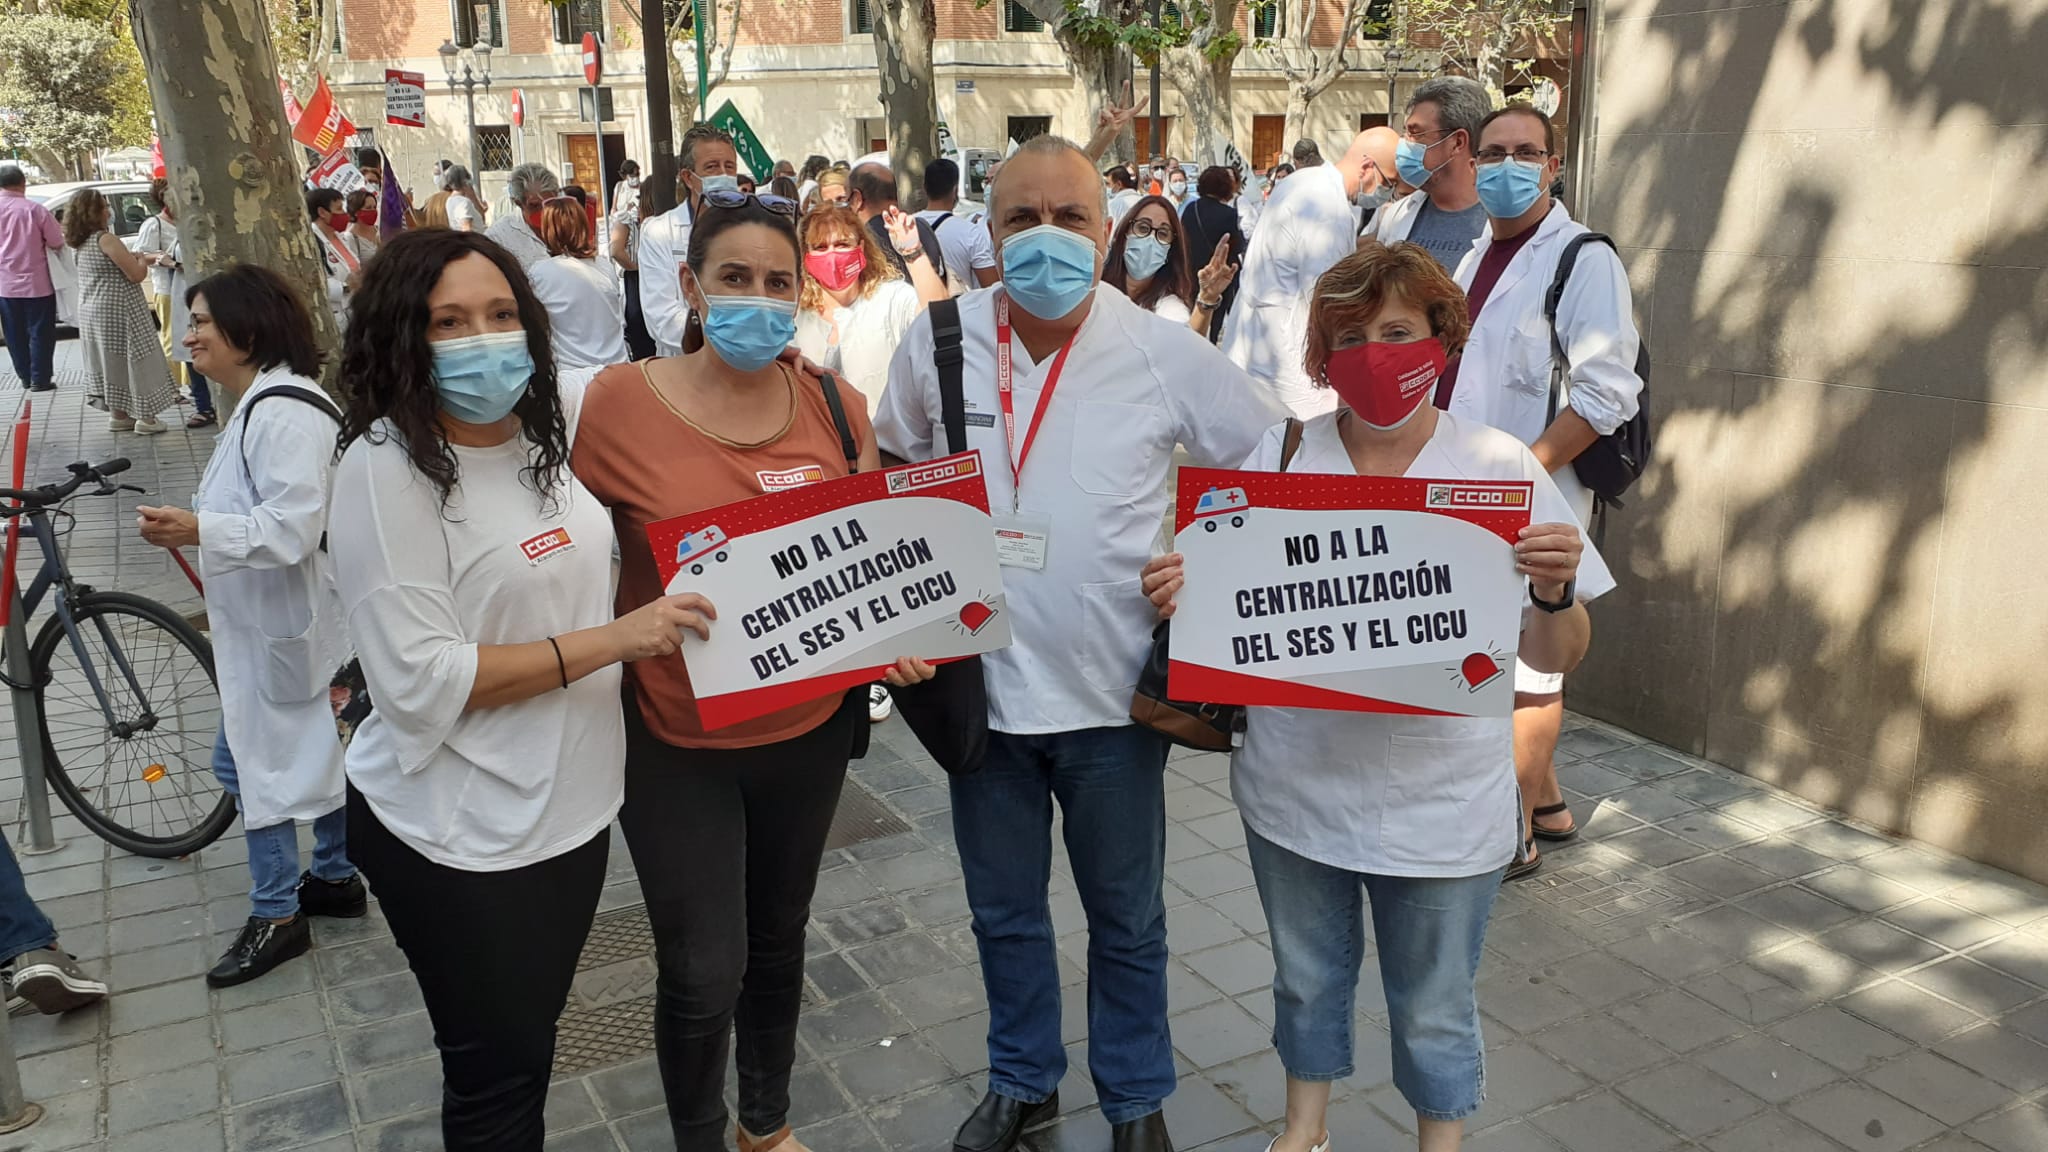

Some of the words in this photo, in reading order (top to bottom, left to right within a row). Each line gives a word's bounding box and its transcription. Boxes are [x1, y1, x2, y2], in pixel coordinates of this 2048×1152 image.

[763, 472, 806, 484] CCOO
[911, 465, 956, 484] CCOO
[1454, 491, 1502, 503] CCOO
[524, 534, 561, 555] CCOO
[770, 544, 808, 580] NO
[810, 533, 833, 562] A
[831, 518, 868, 551] LA
[1284, 533, 1320, 567] NO
[1330, 530, 1348, 561] A
[1355, 525, 1389, 557] LA
[741, 538, 934, 640] CENTRALIZACIÓN
[1235, 559, 1452, 619] CENTRALIZACIÓN
[750, 642, 799, 681] DEL
[798, 617, 845, 656] SES
[845, 606, 864, 632] Y
[867, 595, 900, 624] EL
[901, 570, 957, 611] CICU
[1231, 632, 1280, 665] DEL
[1286, 625, 1335, 658] SES
[1342, 621, 1358, 651] Y
[1367, 618, 1399, 649] EL
[1406, 609, 1468, 644] CICU
